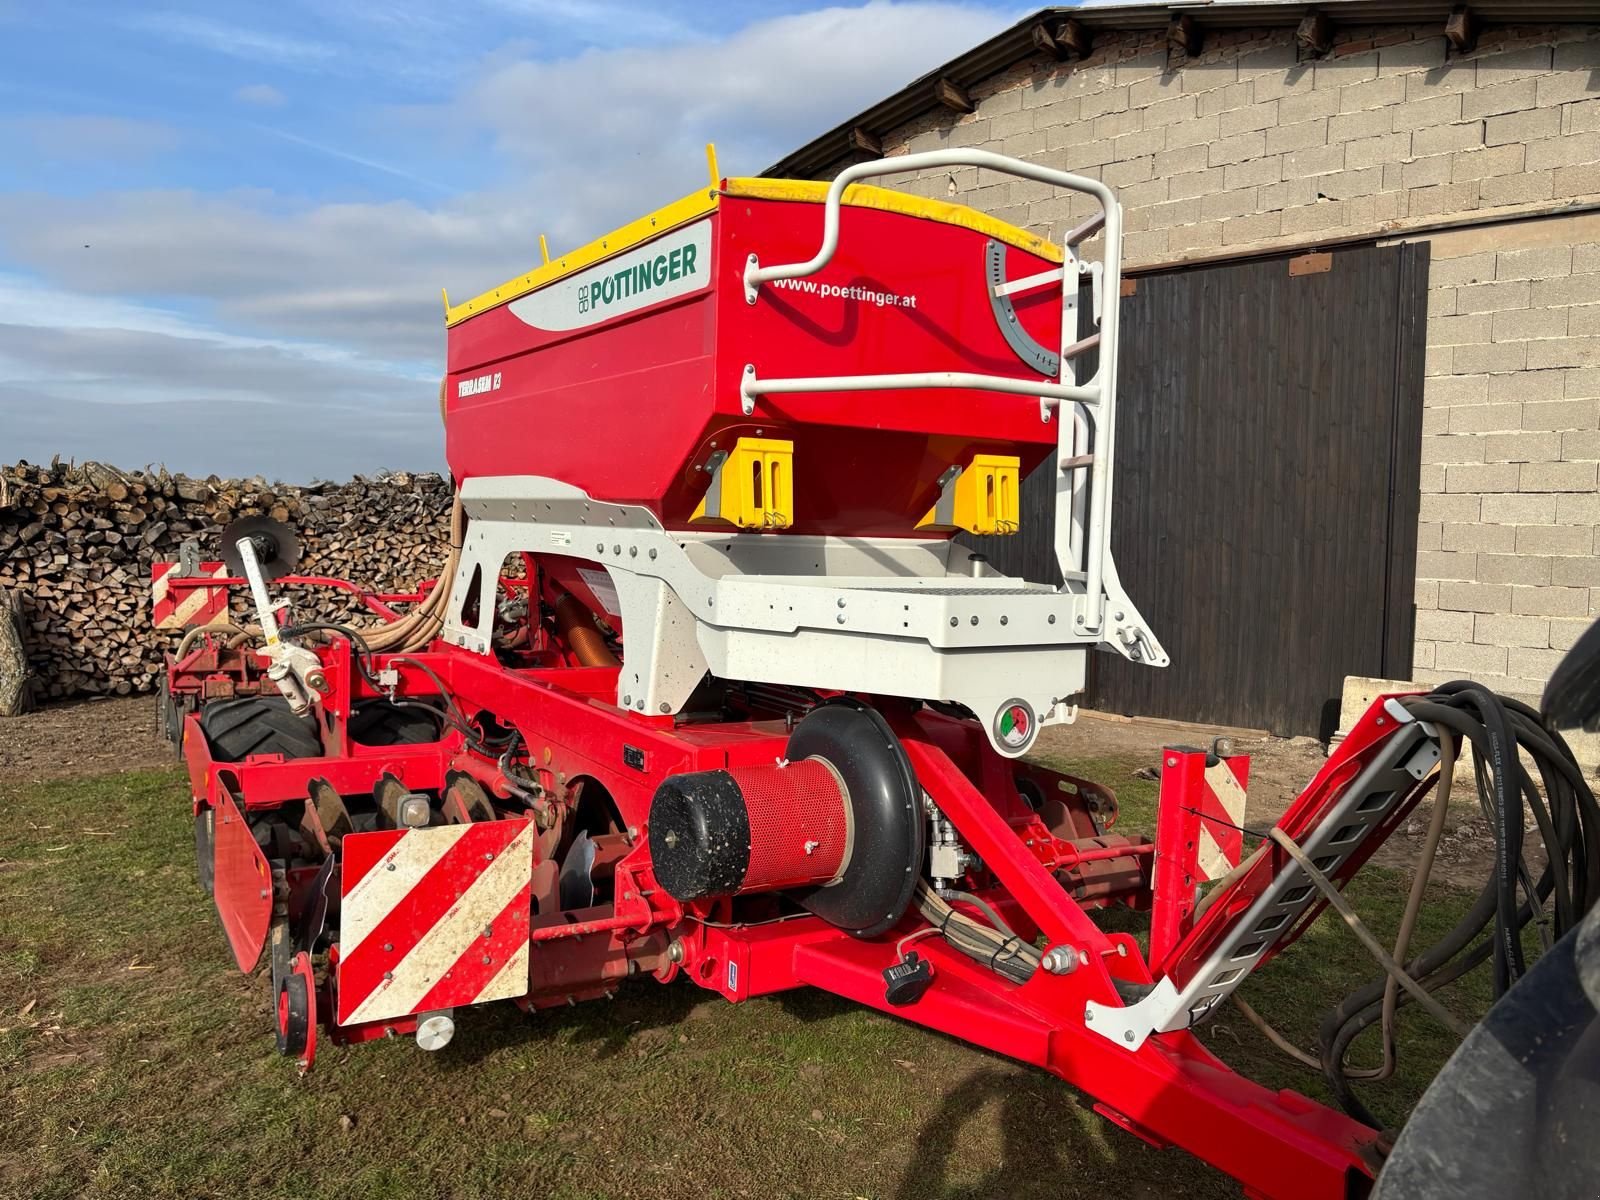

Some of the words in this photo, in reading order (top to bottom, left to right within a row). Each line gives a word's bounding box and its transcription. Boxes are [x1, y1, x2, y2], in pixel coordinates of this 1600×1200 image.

[591, 243, 697, 310] PÖTTINGER
[773, 278, 917, 308] www.poettinger.at
[458, 374, 492, 398] TERRASEM
